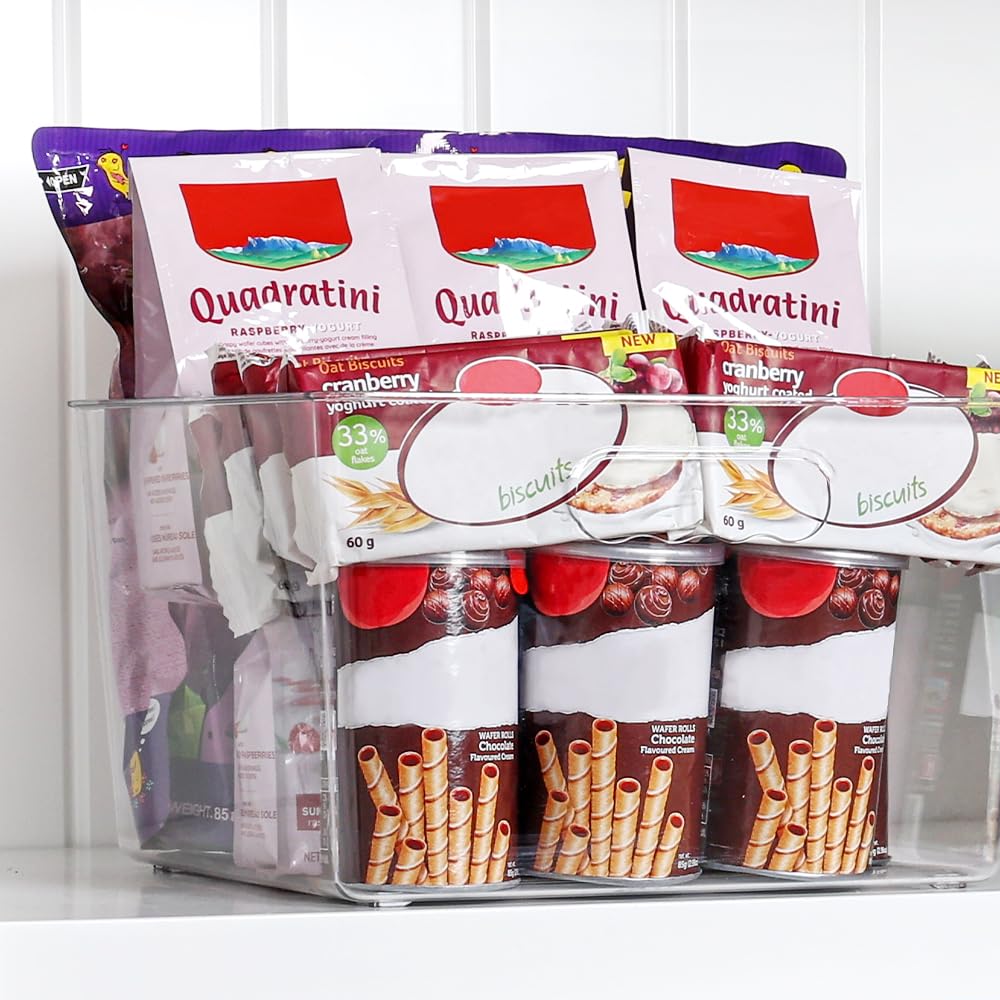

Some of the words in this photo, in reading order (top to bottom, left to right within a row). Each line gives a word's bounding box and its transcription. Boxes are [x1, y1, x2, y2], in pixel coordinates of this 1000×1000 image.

[190, 280, 381, 324] Quadratini
[621, 333, 656, 348] NEW
[721, 341, 741, 354] Oat
[746, 344, 795, 360] Biscuits
[319, 361, 345, 374] Oat
[349, 357, 405, 371] Biscuits
[322, 372, 420, 392] cranberry
[722, 361, 804, 388] cranberry
[727, 408, 763, 433] 33%
[337, 424, 386, 447] 33%
[498, 457, 573, 511] biscuits
[858, 476, 928, 517] biscuits
[723, 516, 735, 527] 60
[737, 519, 745, 530] g
[347, 536, 364, 549] 60
[366, 538, 375, 550] g
[479, 732, 500, 740] WAFER
[651, 724, 677, 734] WAFER
[678, 724, 695, 733] ROLLS
[479, 740, 514, 752] Chocolate
[651, 733, 695, 745] Chocolate
[470, 753, 500, 763] Flavoured
[640, 746, 676, 755] Flavoured
[677, 745, 695, 754] Cream
